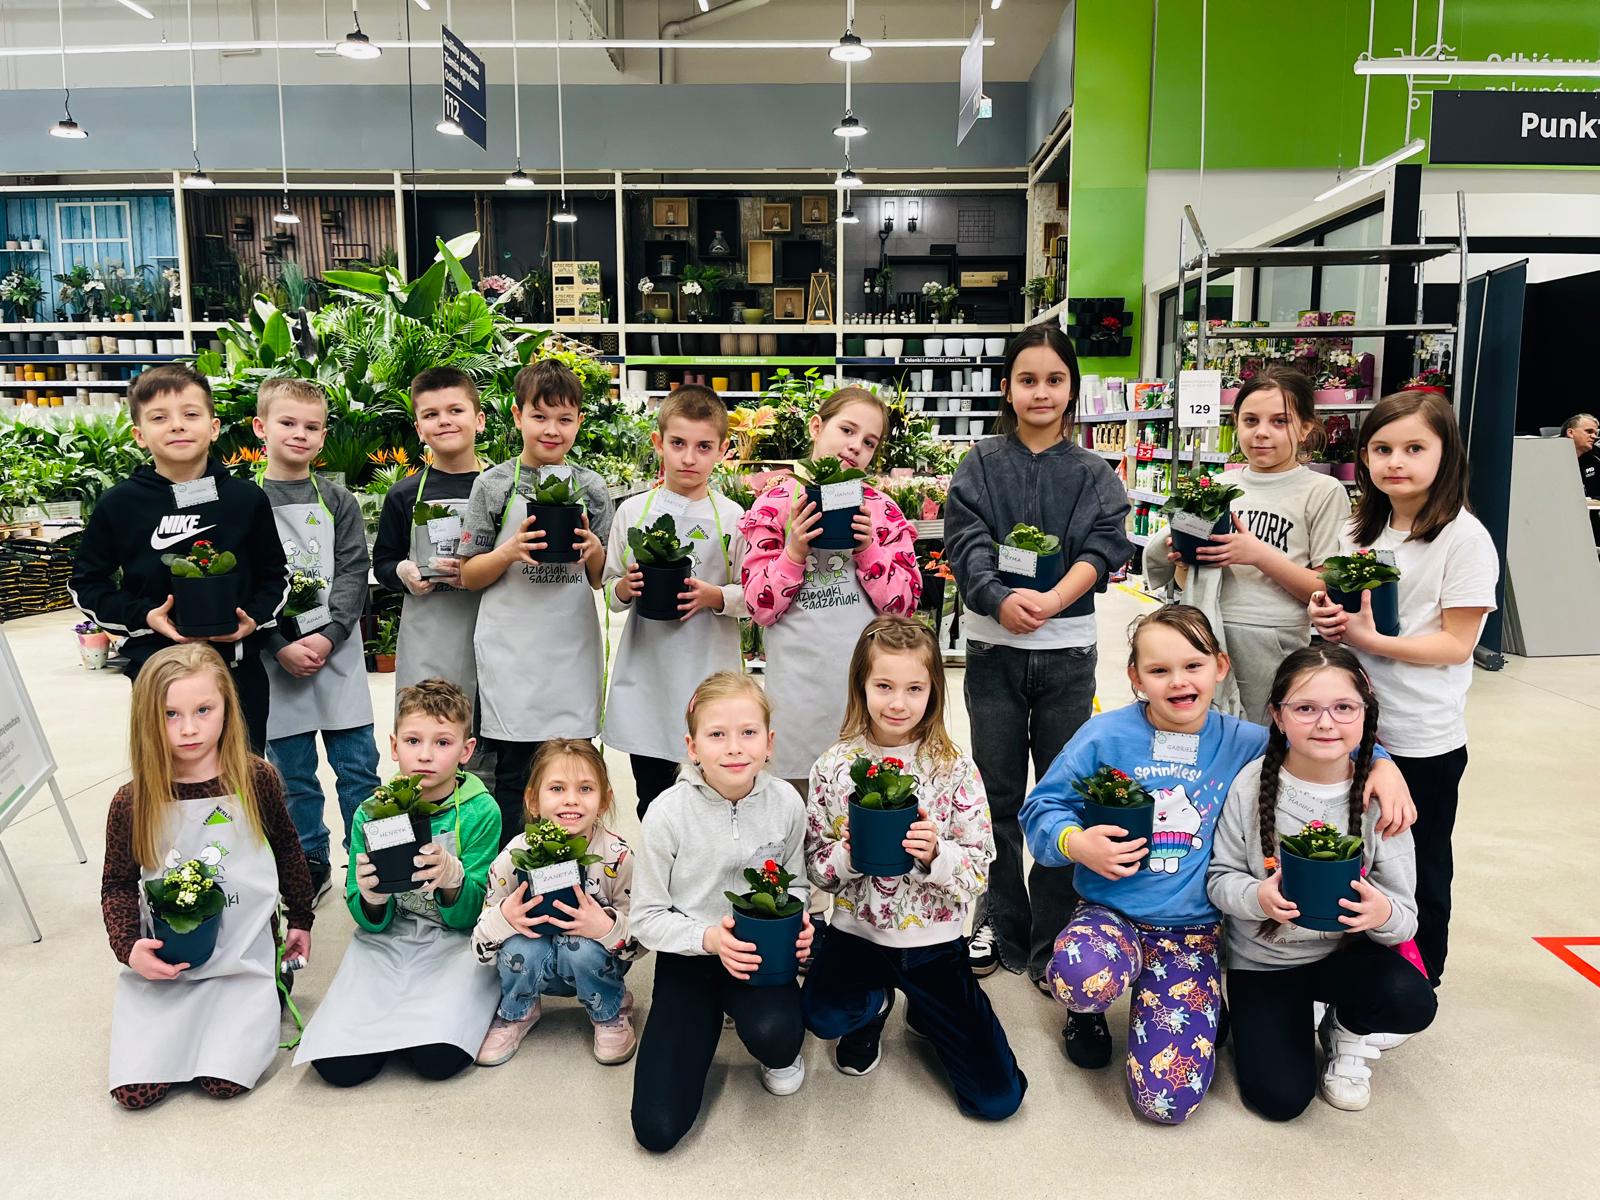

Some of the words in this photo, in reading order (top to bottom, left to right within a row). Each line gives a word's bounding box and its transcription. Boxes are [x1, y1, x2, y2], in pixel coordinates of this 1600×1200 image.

[445, 94, 460, 122] 112
[1521, 111, 1600, 139] Punk
[1190, 404, 1211, 414] 129
[158, 515, 201, 534] NIKE
[1247, 510, 1294, 553] YORK
[802, 592, 860, 610] sadzeniaki
